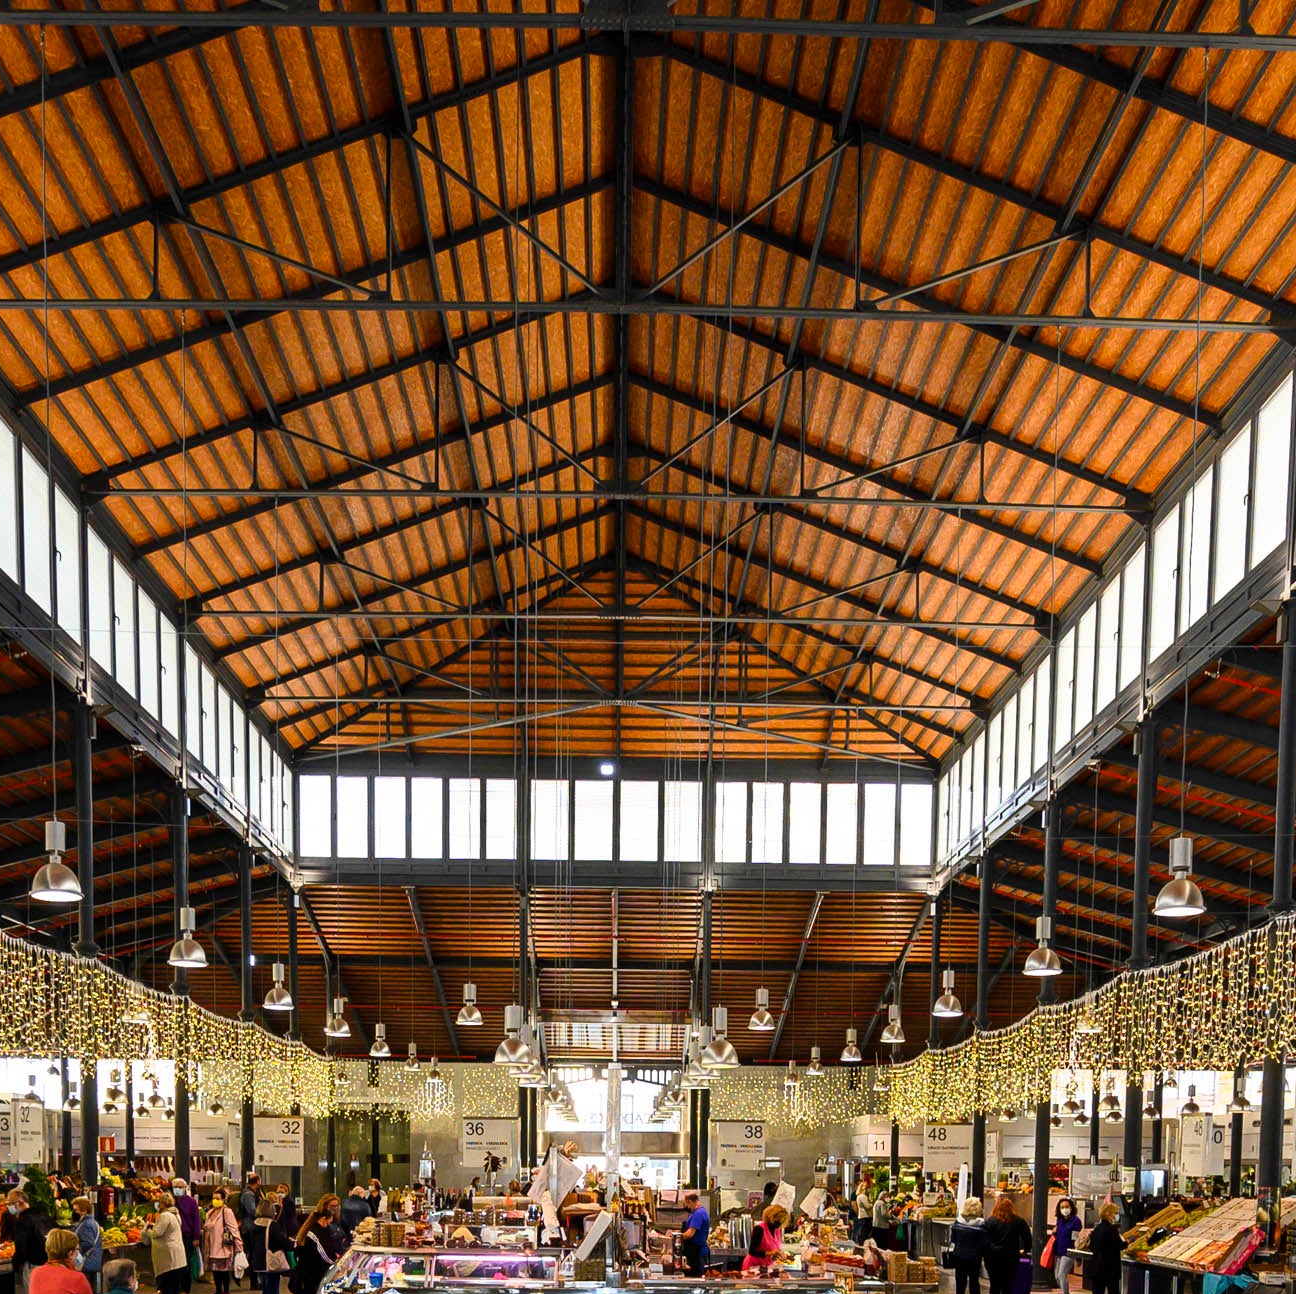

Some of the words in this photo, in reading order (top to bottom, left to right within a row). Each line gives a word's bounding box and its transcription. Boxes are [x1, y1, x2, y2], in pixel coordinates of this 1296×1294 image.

[0, 1117, 9, 1131] 3
[282, 1121, 300, 1134] 32
[466, 1122, 484, 1136] 36
[745, 1125, 763, 1139] 38
[927, 1127, 947, 1141] 48
[873, 1140, 885, 1152] 11
